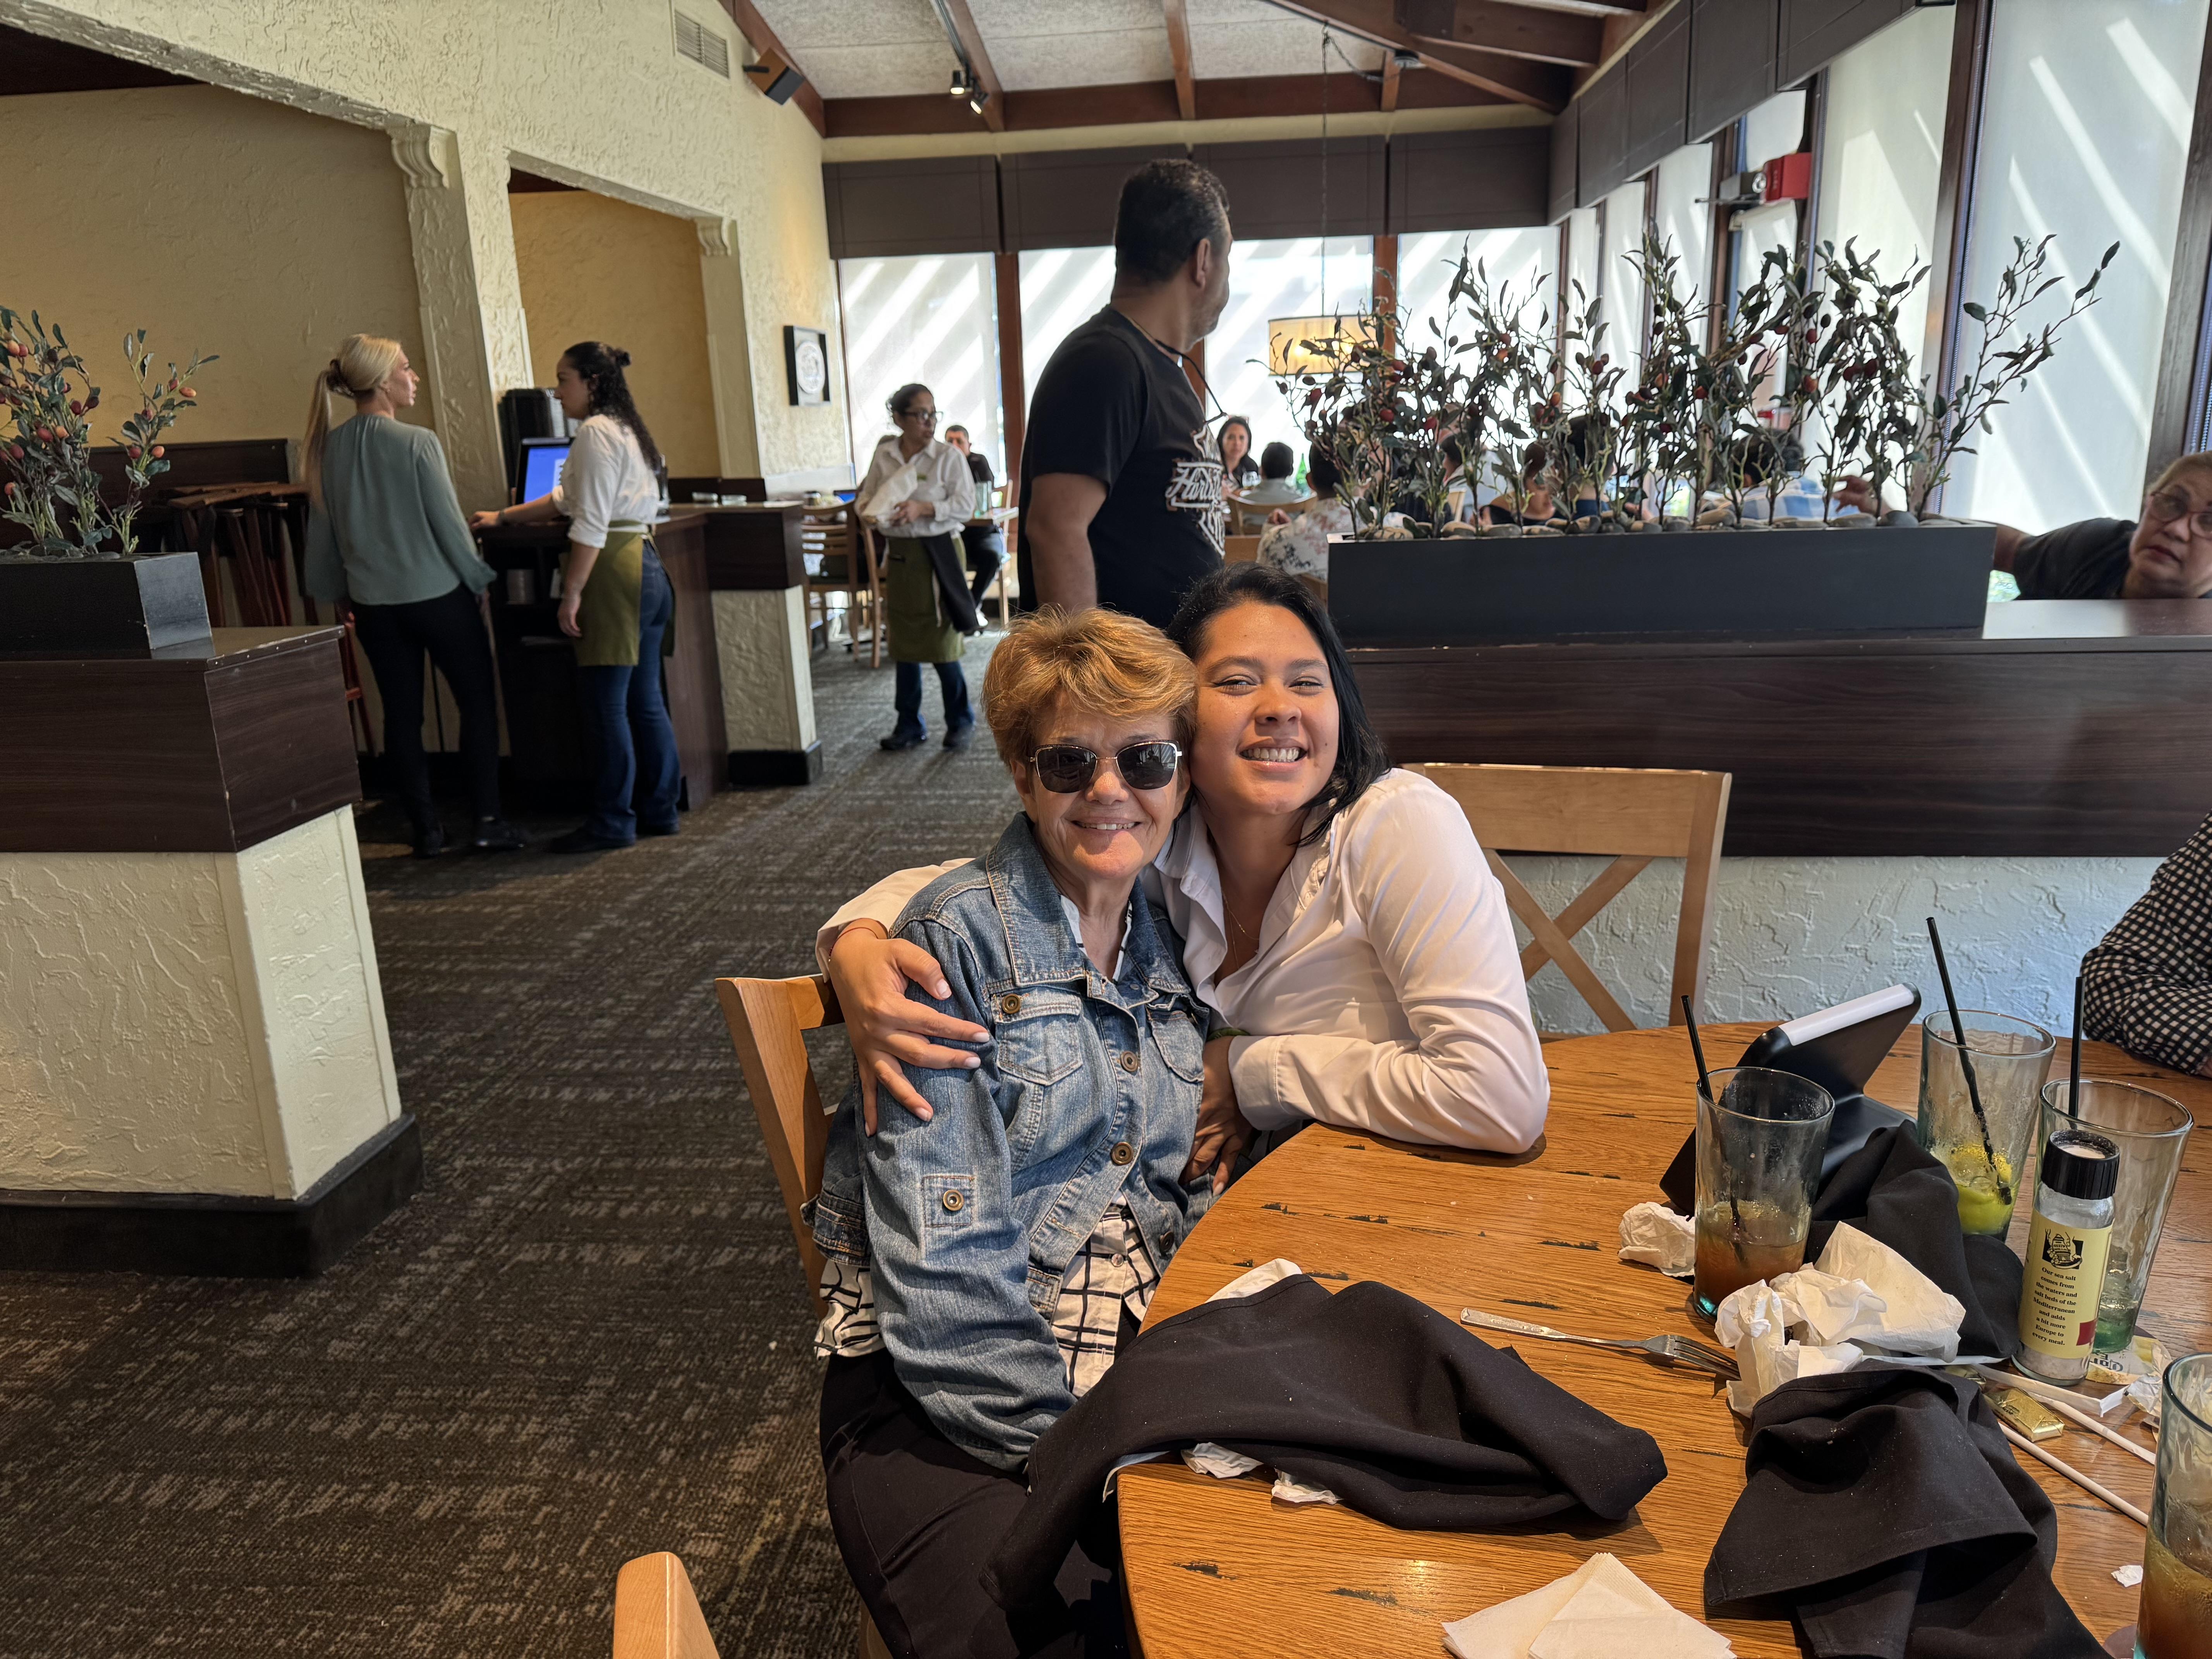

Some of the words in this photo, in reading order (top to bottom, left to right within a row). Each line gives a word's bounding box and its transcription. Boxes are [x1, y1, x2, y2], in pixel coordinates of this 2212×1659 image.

[2041, 1276, 2058, 1285] comes
[2045, 1287, 2065, 1295] waters
[2045, 1294, 2058, 1302] beds
[2033, 1297, 2075, 1313] Mediterranean
[2036, 1324, 2056, 1335] Europe
[2033, 1332, 2047, 1341] every
